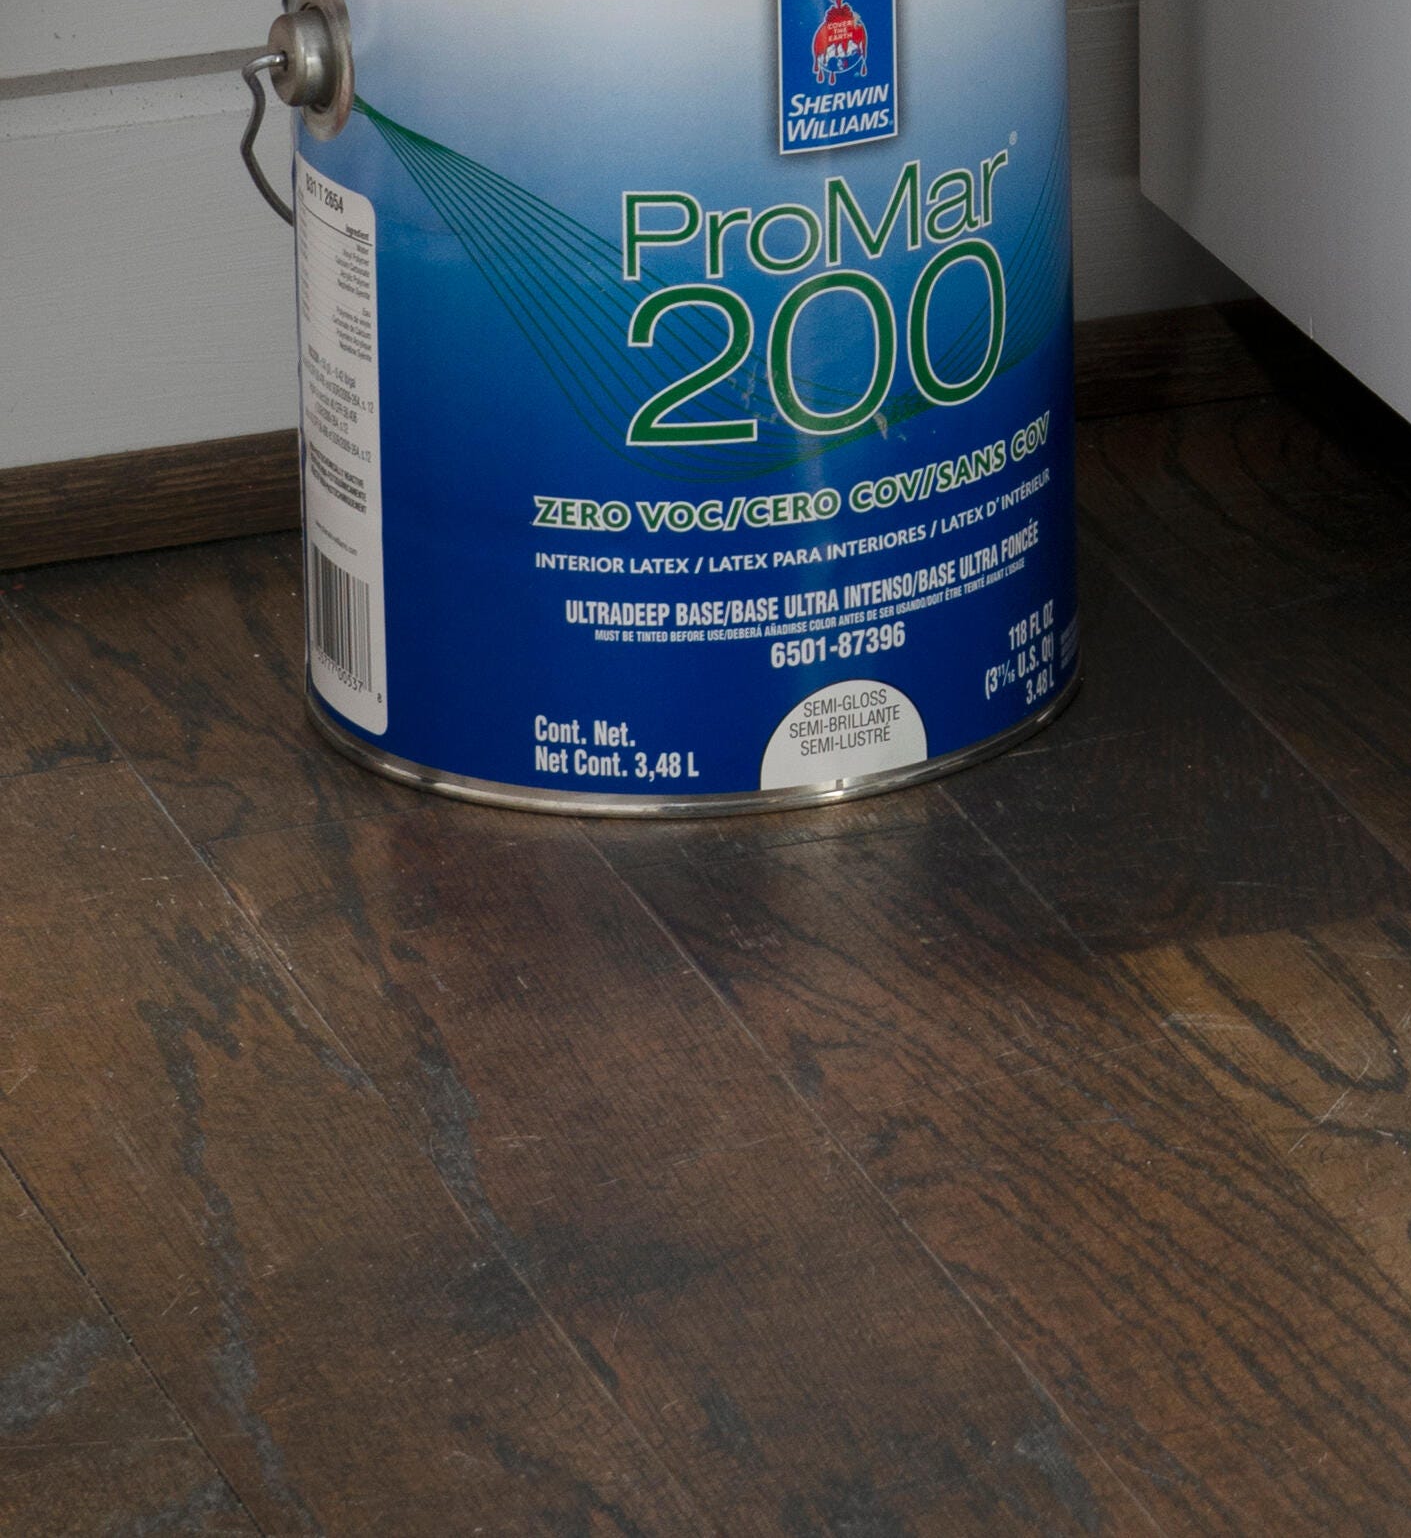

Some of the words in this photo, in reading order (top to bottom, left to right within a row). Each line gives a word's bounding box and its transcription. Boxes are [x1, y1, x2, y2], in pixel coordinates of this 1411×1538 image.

[788, 83, 889, 118] SHERWIN
[787, 108, 890, 144] WILLIAMS
[622, 149, 1008, 281] ProMar
[626, 237, 1006, 448] 200
[532, 494, 632, 533] ZERO
[634, 487, 842, 534] VOC/CERO
[849, 439, 1007, 513] COV/SANS
[1010, 409, 1051, 463] COV
[535, 552, 625, 574] INTERIOR
[629, 557, 690, 575] LATEX
[708, 552, 769, 574] LATEX
[772, 543, 823, 568] PARA
[826, 523, 927, 561] INTERIORES
[940, 504, 984, 535] LATEX
[1001, 466, 1051, 512] INTÉRIEUR
[565, 599, 671, 628] ULTRADEEP
[675, 596, 780, 628] BASE/BASE
[784, 588, 839, 619] ULTRA
[843, 559, 957, 611] INTENSO/BASE
[959, 543, 999, 581] ULTRA
[1000, 517, 1040, 564] FONCÉE
[594, 629, 621, 643] MUST
[622, 630, 635, 643] BE
[636, 630, 669, 643] TINTED
[670, 630, 706, 644] BEFORE
[707, 624, 763, 642] USE/DEBERÁ
[764, 620, 809, 638] AÑADIRSE
[808, 613, 838, 633] COLOR
[838, 610, 866, 628] ANTES
[866, 609, 879, 622] DE
[878, 604, 896, 619] SER
[1008, 619, 1028, 651] 118
[1029, 610, 1042, 640] FL
[1042, 598, 1055, 630] OZ
[770, 620, 908, 670] 6501-87396
[1017, 644, 1040, 678] U.S.
[803, 687, 889, 719] SEMI-GLOSS
[1026, 668, 1049, 706] 3.48
[1049, 663, 1055, 688] L
[535, 714, 587, 745] Cont.
[593, 719, 637, 748] Net.
[788, 703, 902, 740] SEMI-BRILLANTE
[799, 721, 892, 758] SEMI-LUSTRÉ
[535, 745, 569, 774] Net
[573, 748, 628, 778] Cont.
[635, 751, 682, 783] 3,48
[687, 751, 700, 778] L
